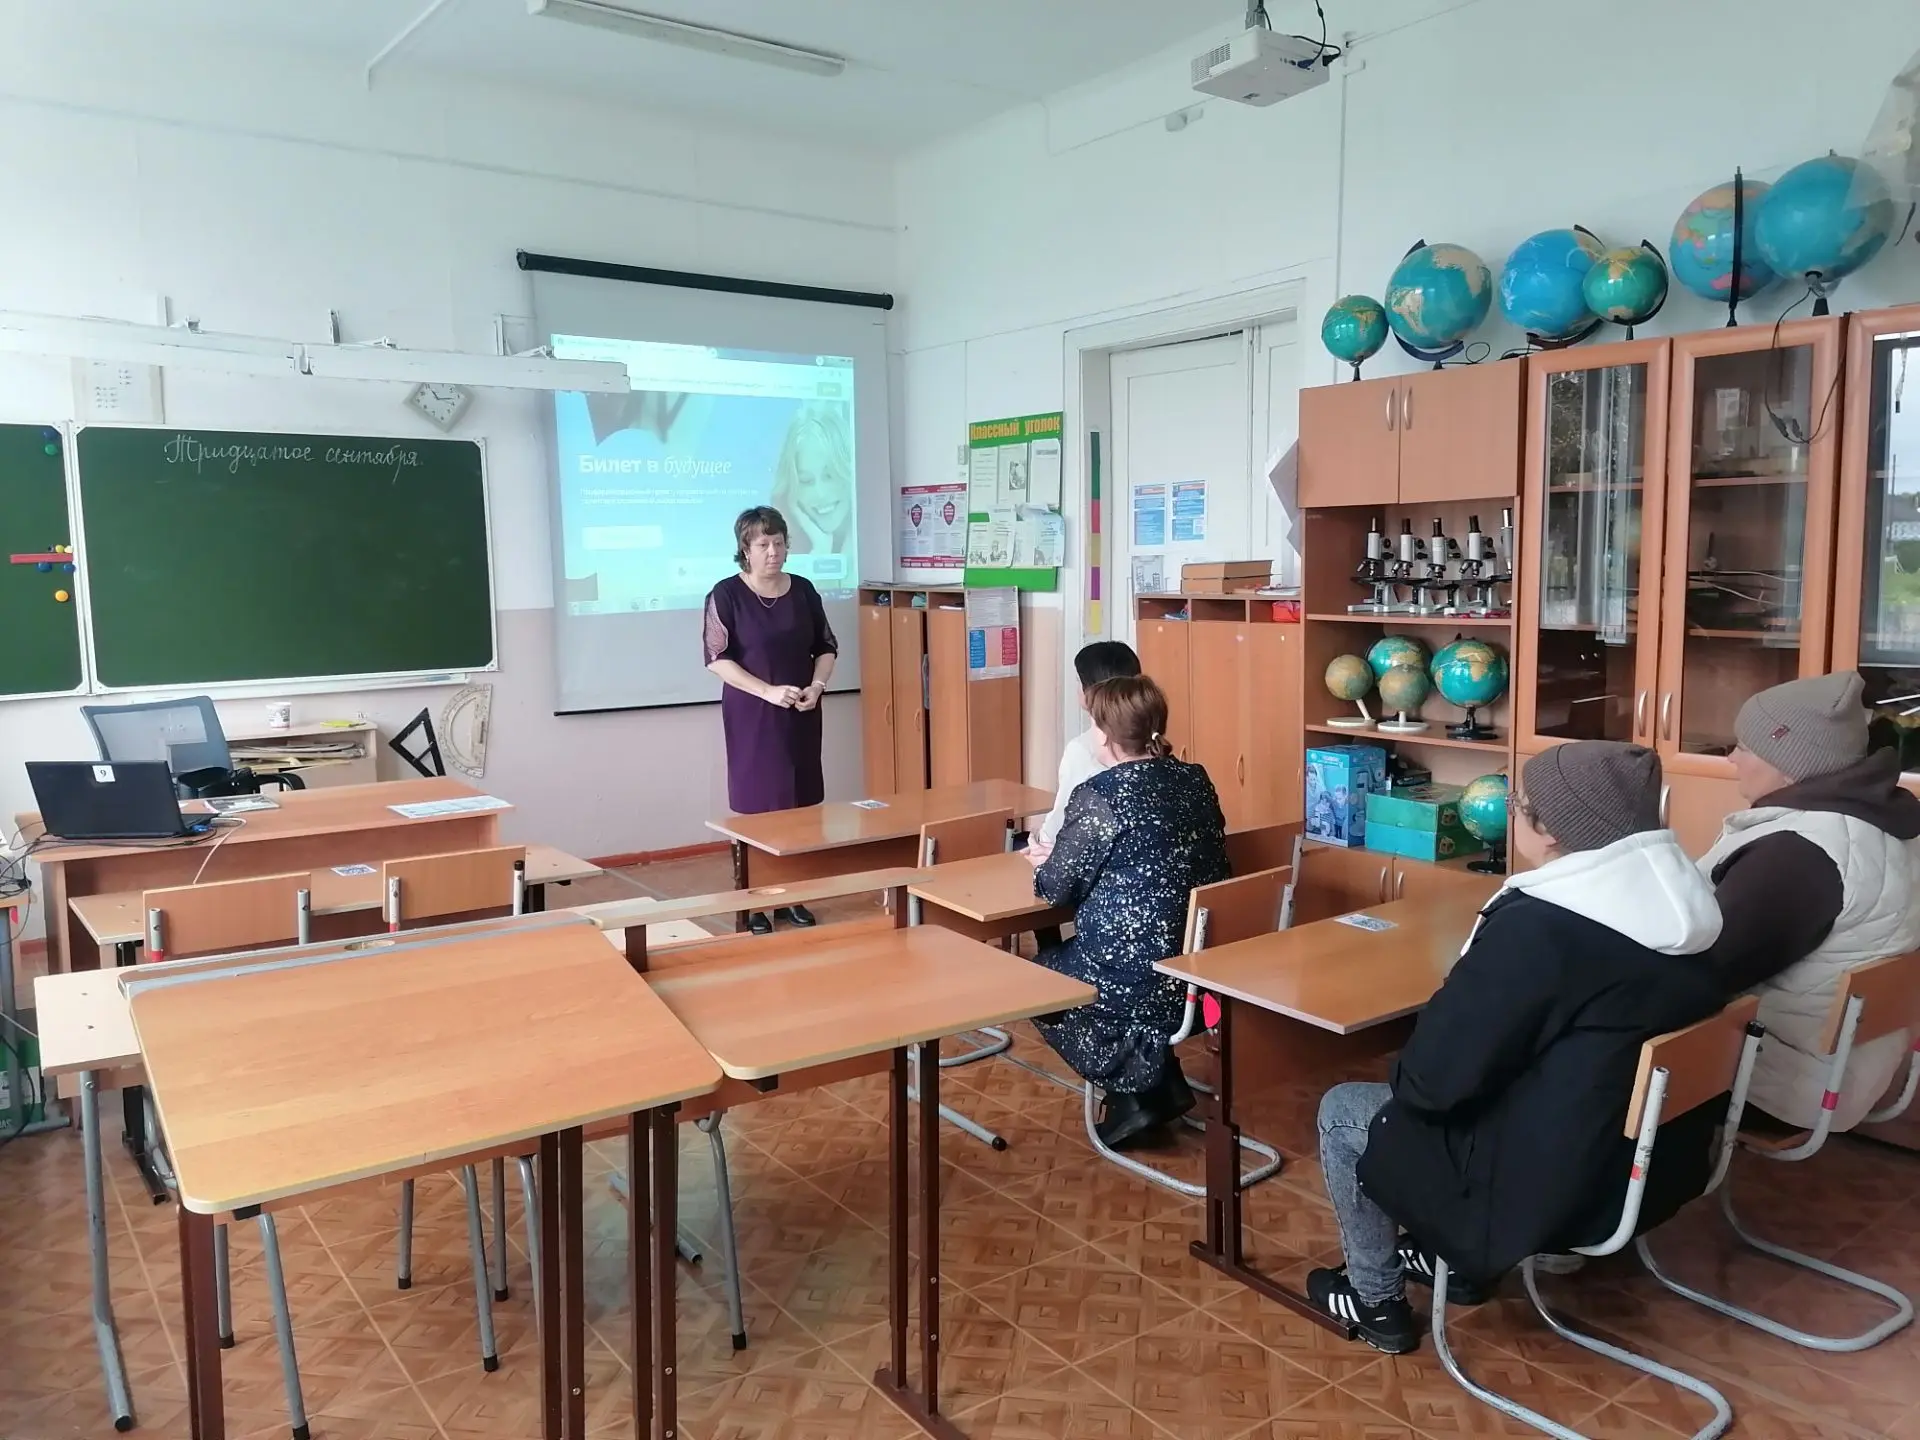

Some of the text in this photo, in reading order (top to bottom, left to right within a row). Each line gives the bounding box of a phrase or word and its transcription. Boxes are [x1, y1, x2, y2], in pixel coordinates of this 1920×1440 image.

[970, 419, 1020, 440] Классный
[164, 434, 314, 474] Тридцатое
[579, 454, 732, 479] Билет в будущее
